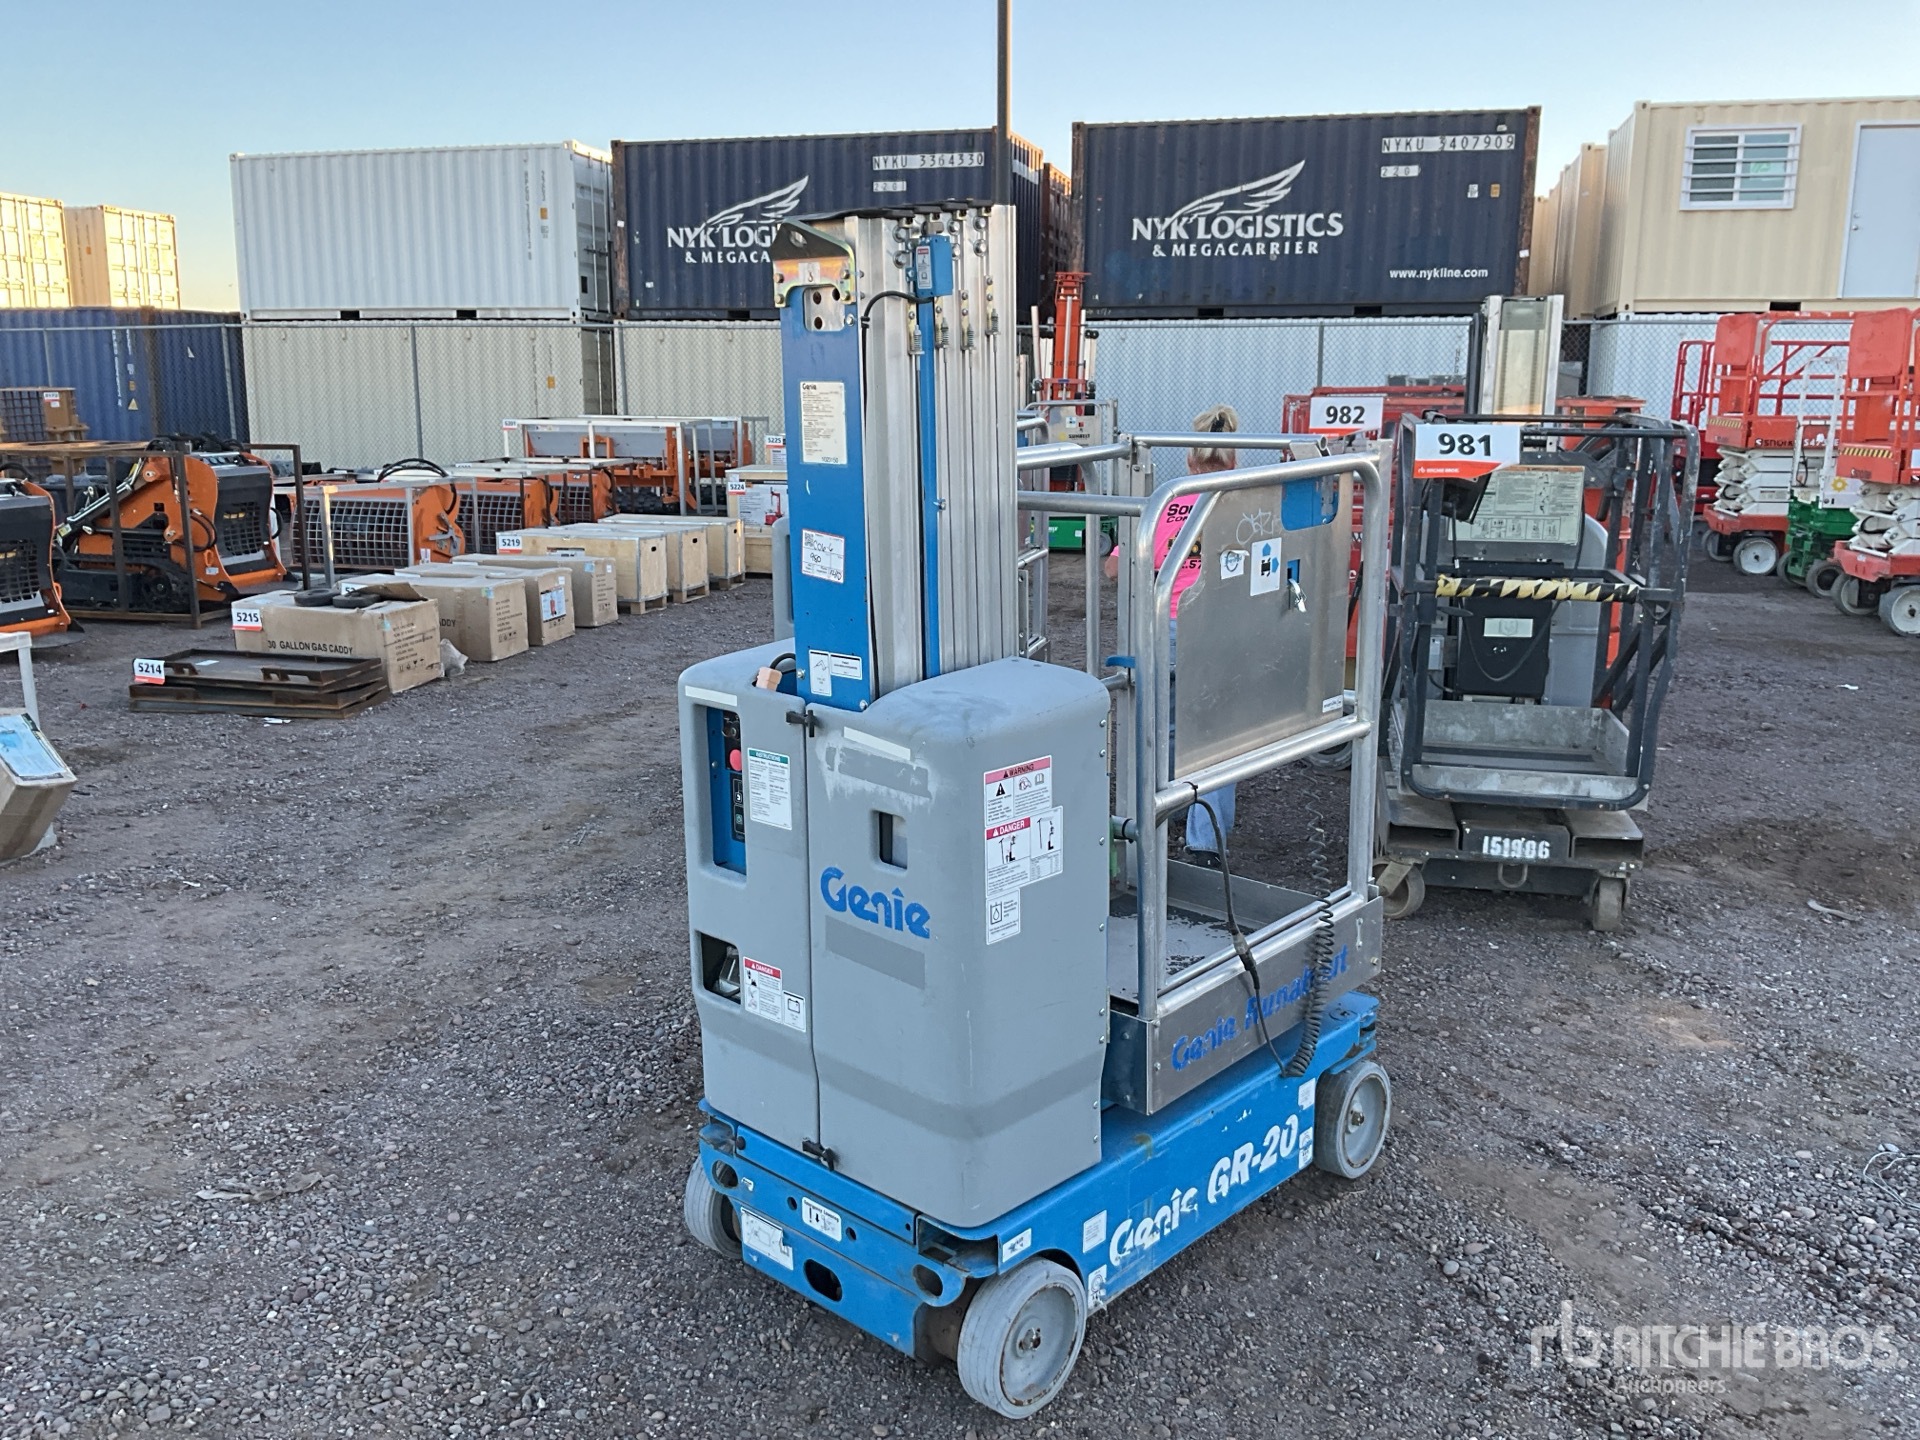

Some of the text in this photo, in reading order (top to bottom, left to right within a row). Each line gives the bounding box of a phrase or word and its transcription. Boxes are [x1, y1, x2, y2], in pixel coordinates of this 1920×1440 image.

[1382, 138, 1425, 152] NYKU
[873, 153, 984, 169] NYKU 3364330
[1382, 165, 1421, 177] 22G
[1131, 212, 1344, 241] NYK LOGISTICS
[667, 224, 776, 249] NYK LOGI
[685, 250, 771, 264] & MEGACA
[1152, 241, 1319, 257] & MEGACARRIER
[1389, 267, 1489, 281] www.nykline.com
[1325, 405, 1366, 425] 982
[1437, 432, 1492, 457] 981
[502, 538, 521, 547] 5219
[236, 612, 259, 623] 5215
[267, 639, 353, 656] 30 GALLON GAS CADDY
[138, 662, 162, 675] 5214
[1009, 763, 1034, 777] WARNING
[999, 819, 1025, 835] DANGER
[820, 865, 931, 940] Genie
[755, 963, 774, 976] DANGER
[1170, 1015, 1237, 1072] Genie
[1207, 1113, 1299, 1205] GR-20
